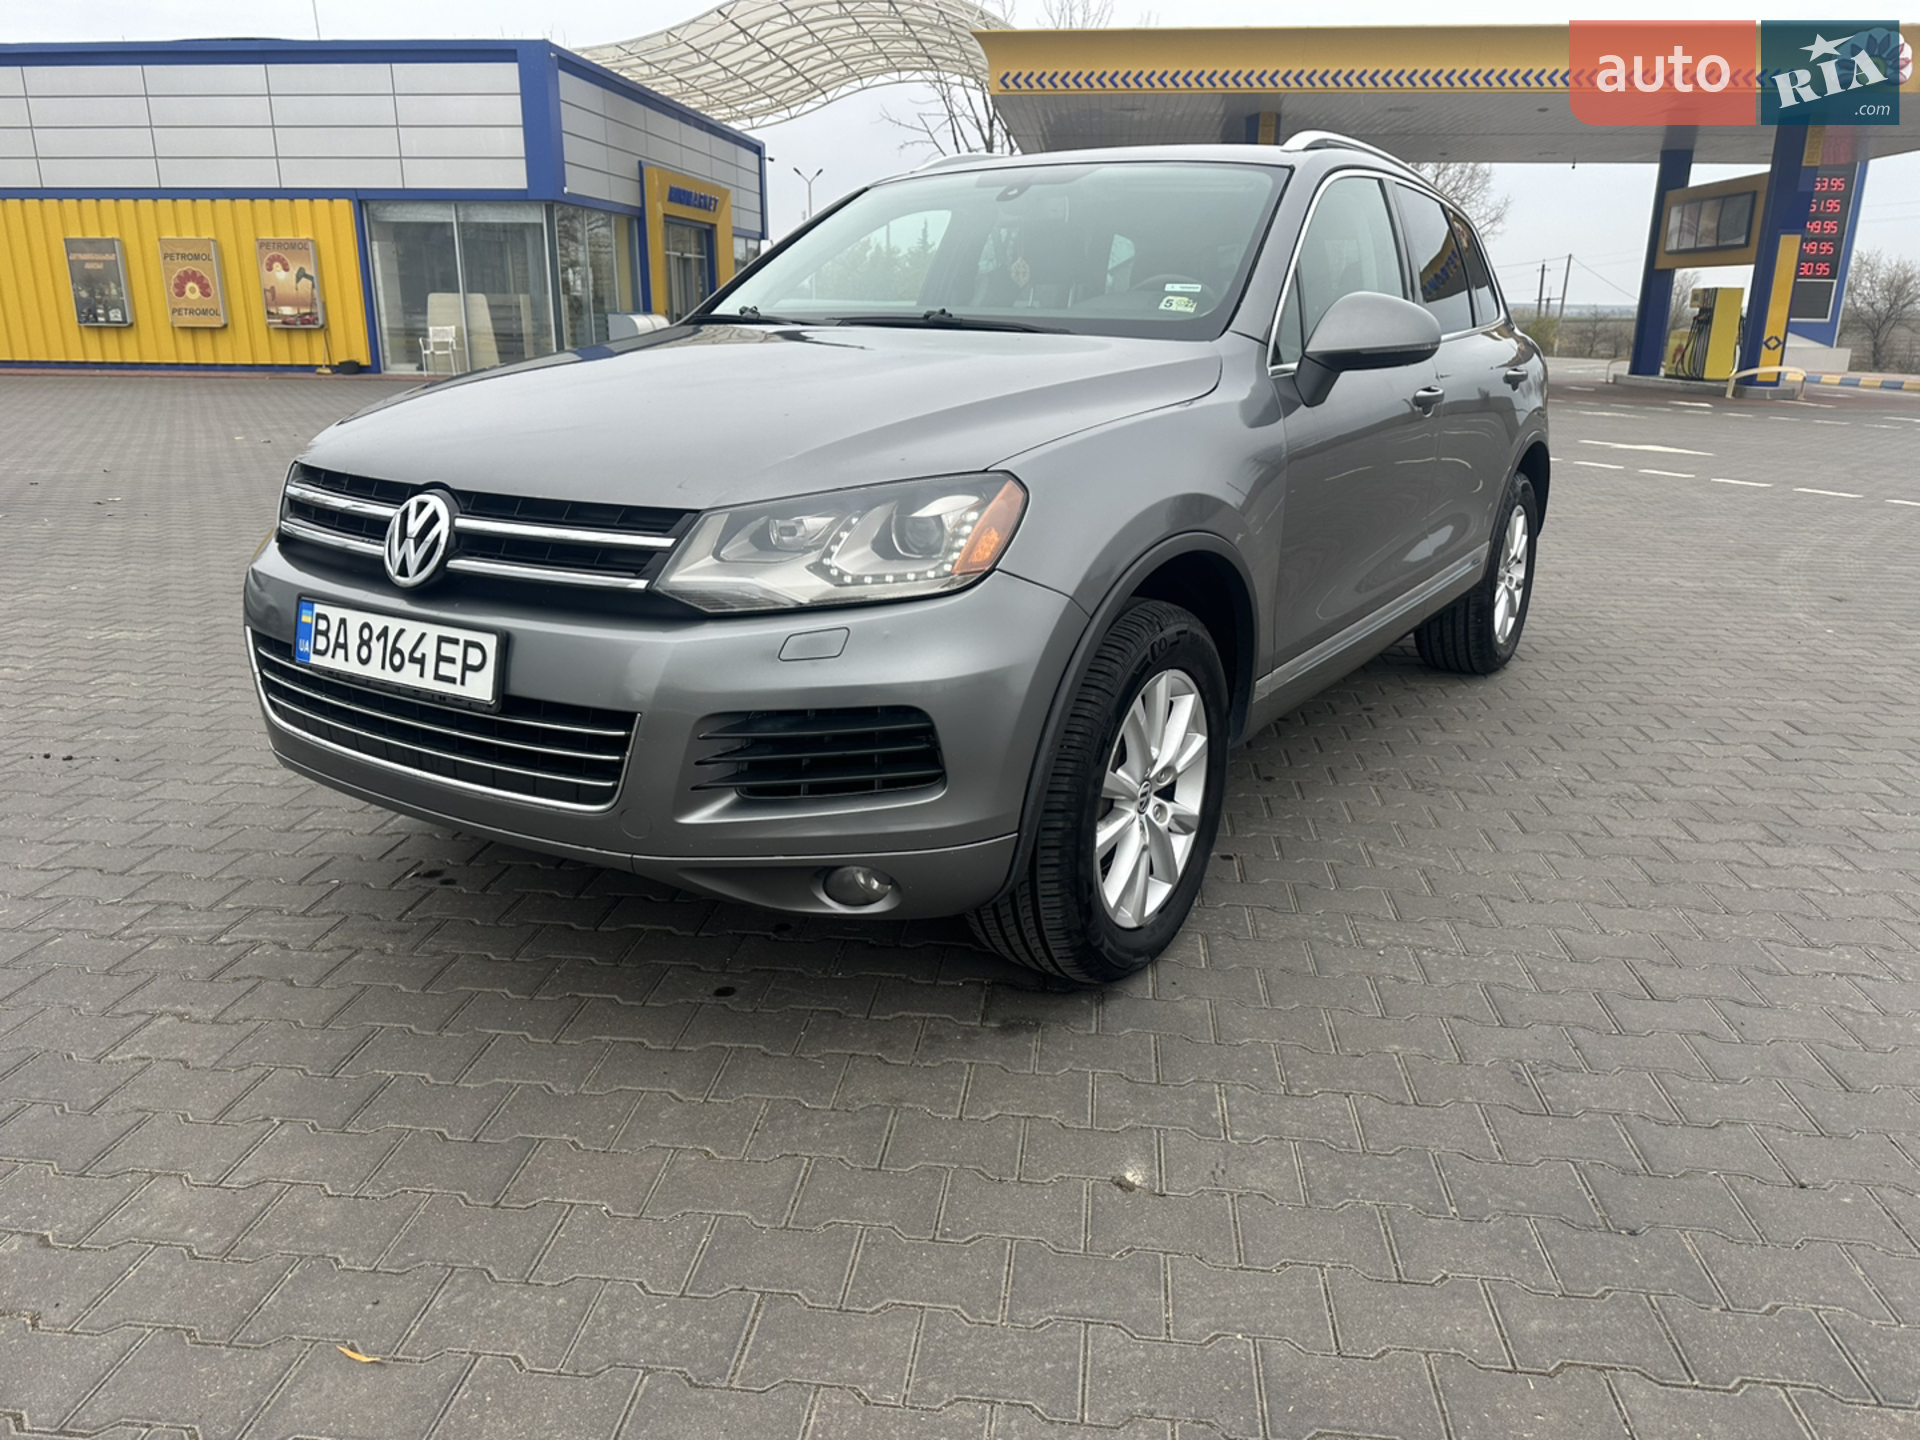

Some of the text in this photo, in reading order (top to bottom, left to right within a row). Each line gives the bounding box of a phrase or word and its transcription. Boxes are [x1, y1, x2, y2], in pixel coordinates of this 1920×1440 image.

[259, 241, 309, 250] PETROMOL
[163, 252, 213, 261] PETROMOL
[171, 307, 221, 316] PETROMOL
[299, 639, 310, 653] UA
[312, 612, 487, 686] BA 8164 EP
